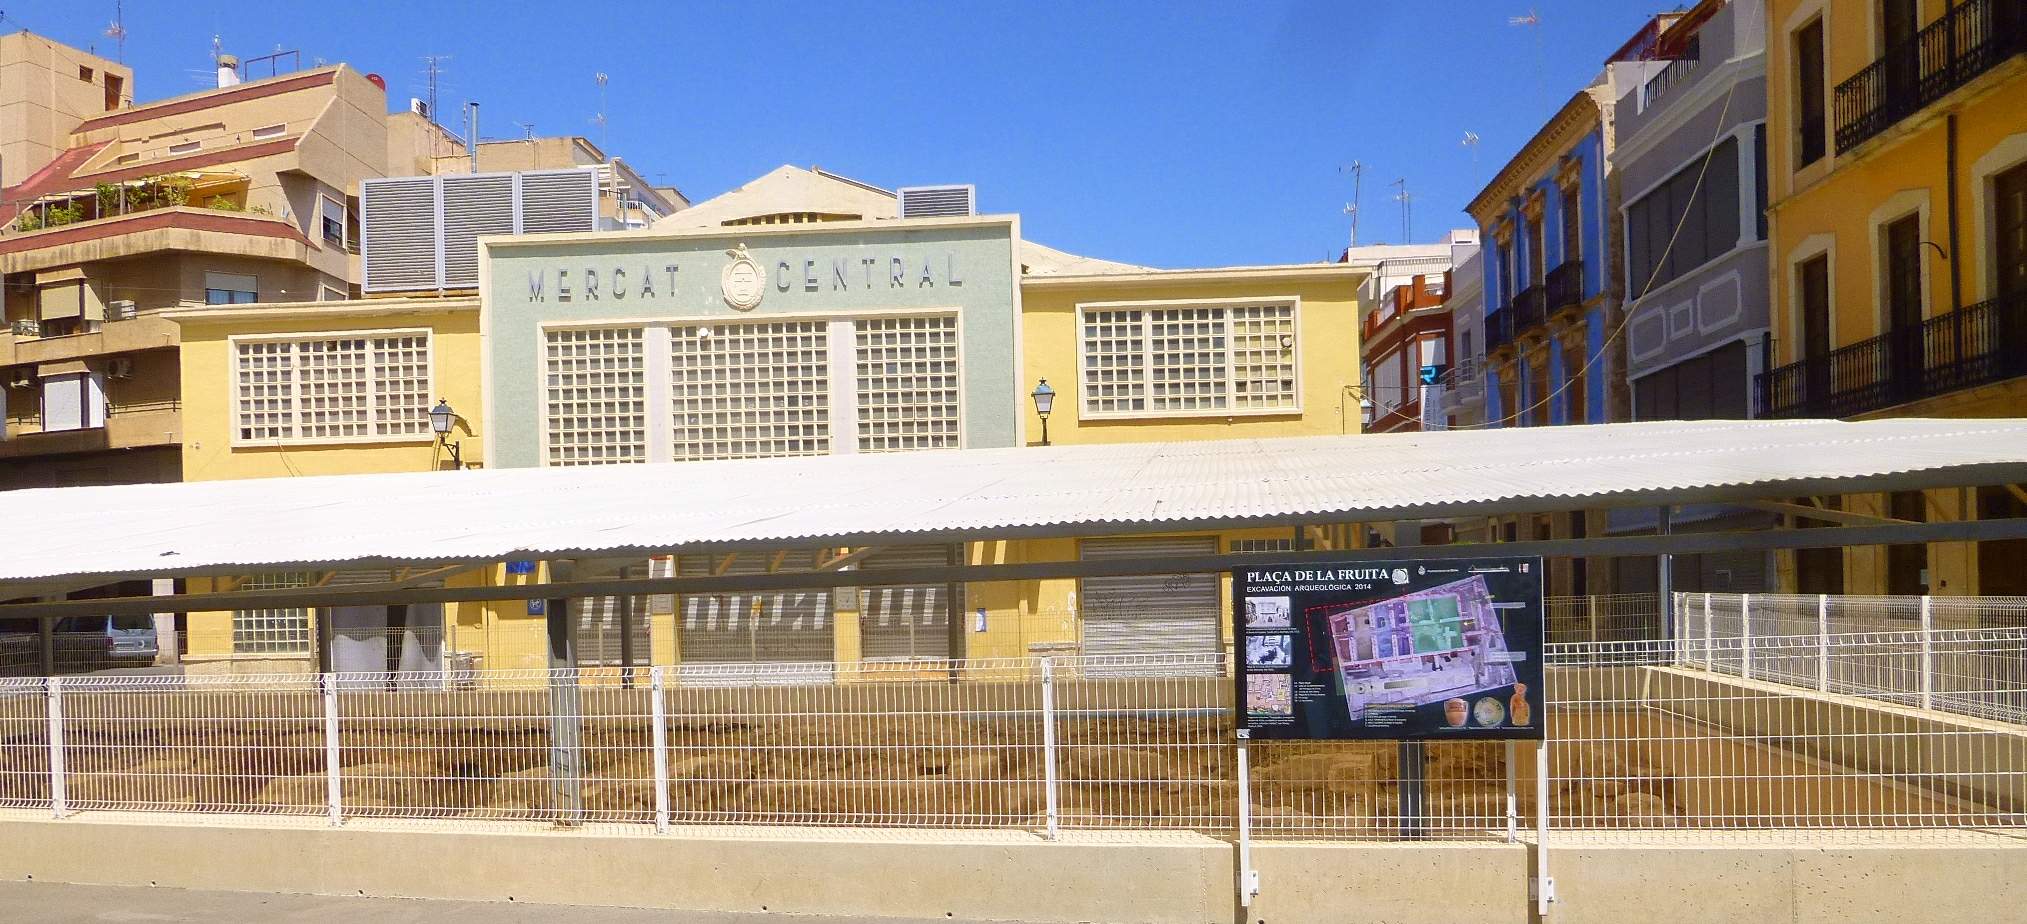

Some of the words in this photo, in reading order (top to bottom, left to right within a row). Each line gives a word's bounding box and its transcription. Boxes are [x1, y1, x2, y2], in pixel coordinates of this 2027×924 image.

[528, 263, 679, 302] MERCAT
[776, 250, 963, 291] CENTRAL
[1247, 570, 1292, 584] PLAÇA
[1295, 570, 1314, 582] DE
[1317, 569, 1335, 581] LA
[1337, 568, 1389, 581] FRUITA
